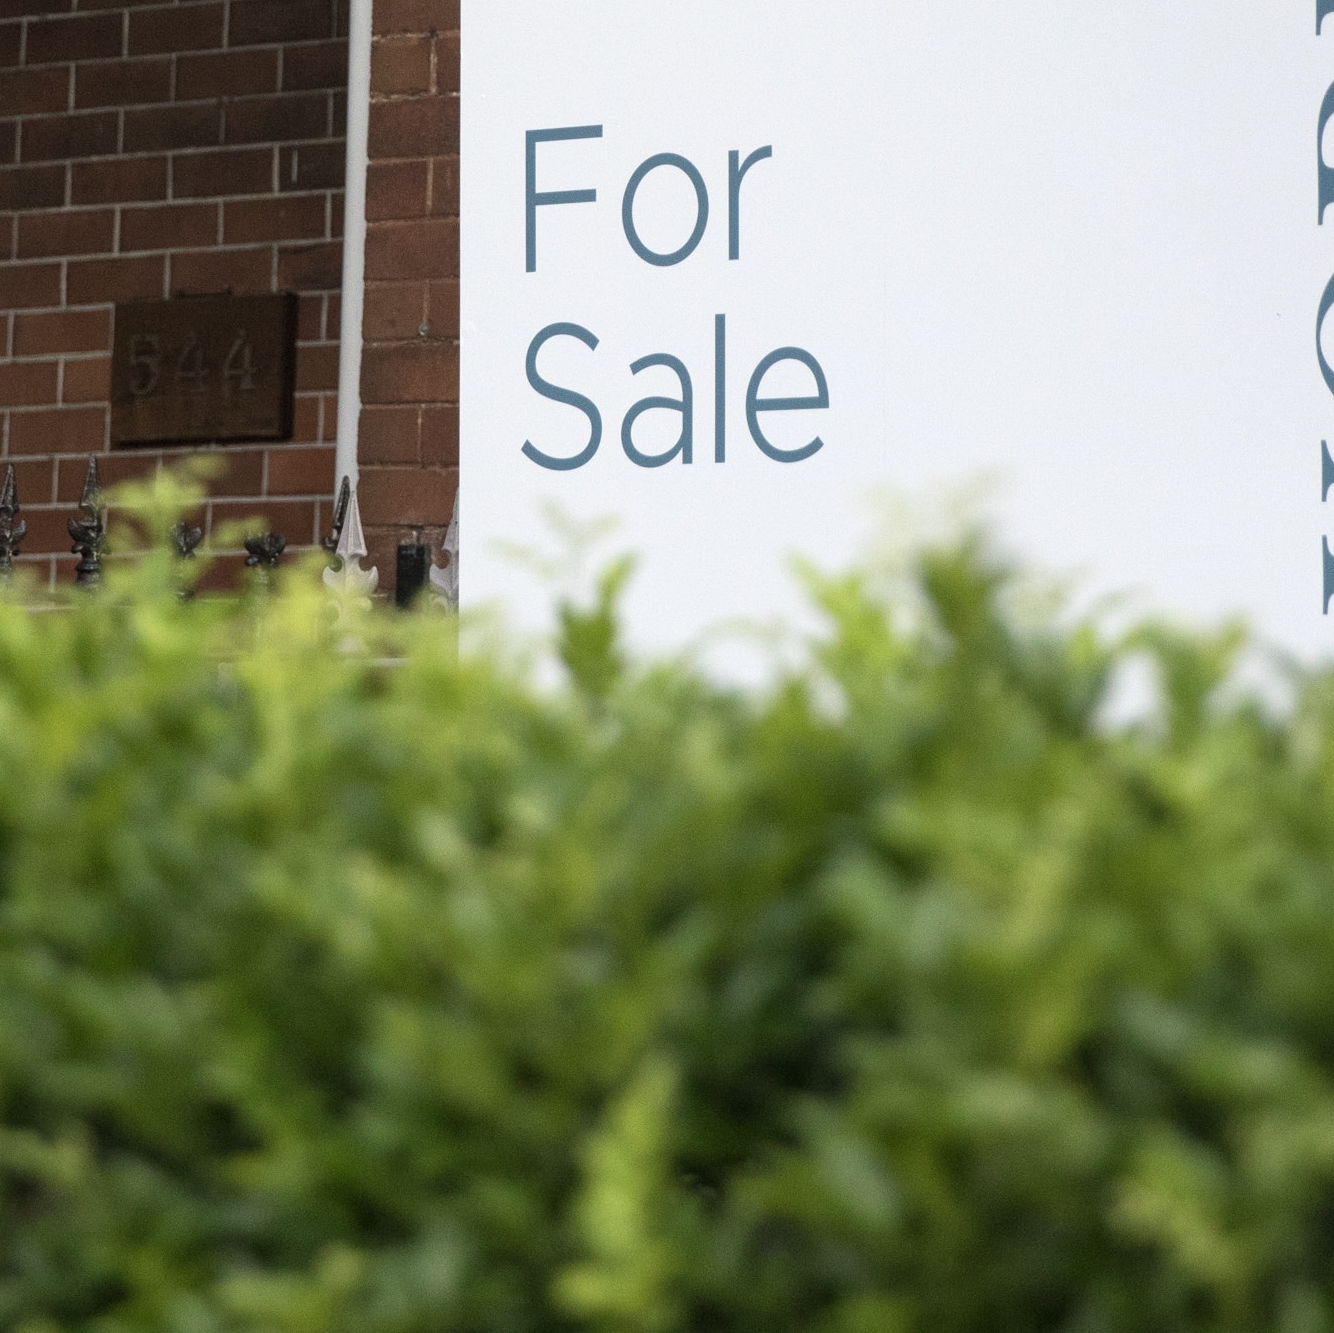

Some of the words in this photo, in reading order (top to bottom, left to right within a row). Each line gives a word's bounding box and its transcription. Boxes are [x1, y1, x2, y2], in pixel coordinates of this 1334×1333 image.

[525, 124, 773, 273] For
[128, 328, 259, 395] 544
[521, 313, 830, 472] Sale
